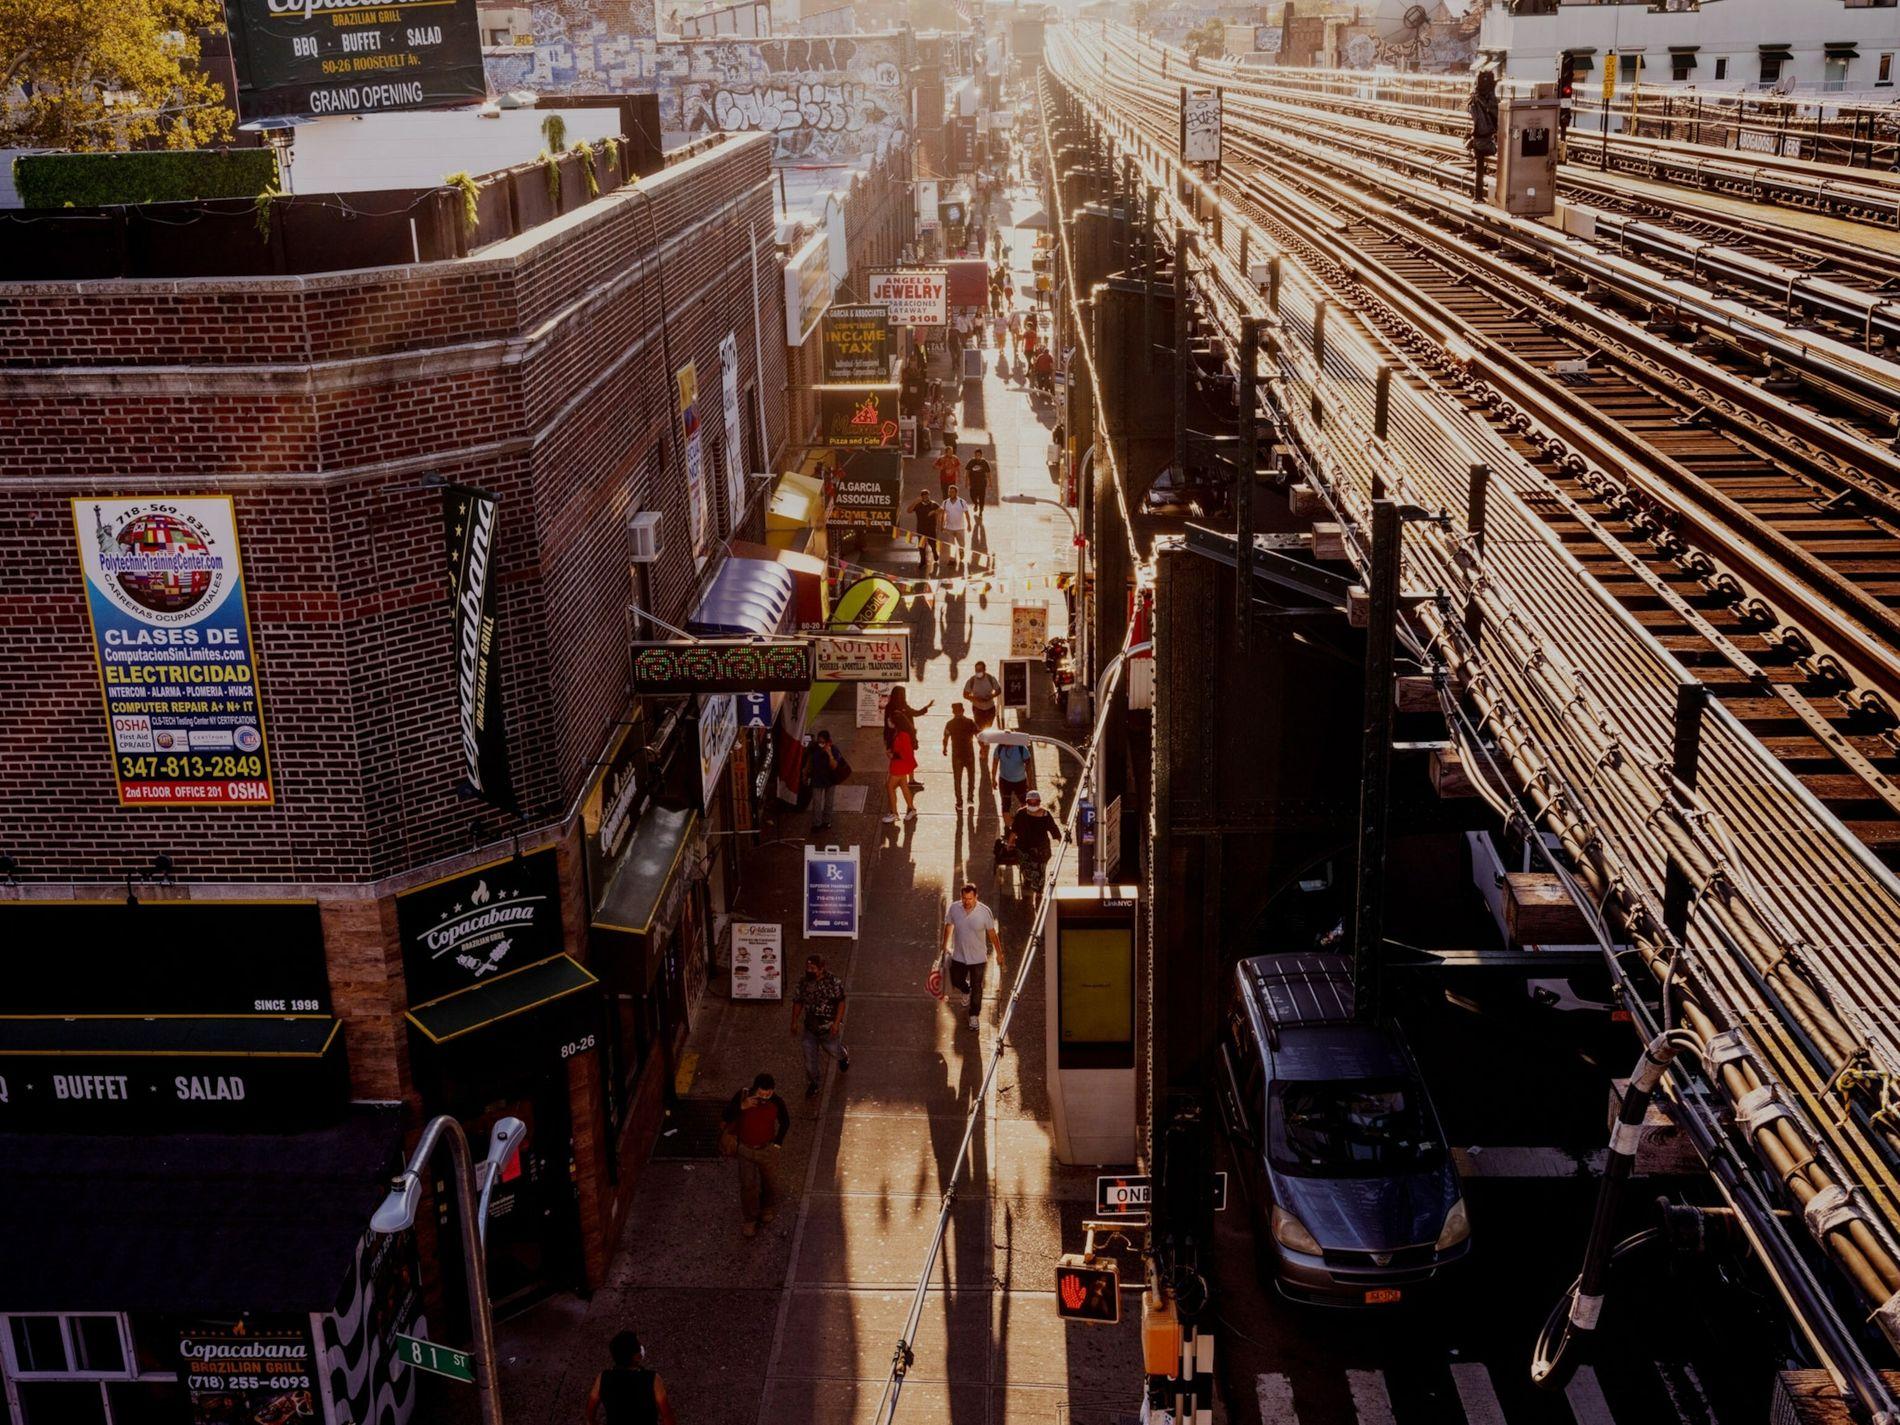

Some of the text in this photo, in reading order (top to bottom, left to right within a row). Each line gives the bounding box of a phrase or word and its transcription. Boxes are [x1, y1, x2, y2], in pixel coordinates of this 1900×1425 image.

[332, 9, 402, 27] BRAZILIAN GRILL
[293, 26, 442, 57] BBQ BUFFET SALAD
[322, 56, 351, 74] 80-26
[353, 54, 406, 71] ROOSEVELT
[310, 81, 423, 113] GRAND OPENING
[885, 276, 931, 285] ANGELO
[873, 285, 943, 299] JEWELRY
[825, 330, 886, 342] INCOME
[838, 342, 873, 354] TAX
[849, 437, 862, 445] and
[836, 494, 891, 505] ASSOCIATES
[870, 510, 891, 520] TAX
[99, 553, 223, 574] PolytechnicTrainingCenter.com
[104, 573, 223, 622] CARRERAS OCUPACIONALES
[105, 628, 239, 645] CLASES DE
[105, 647, 245, 664] ComputacionSinLimites.com
[105, 665, 251, 683] ELECTRICIDAD
[475, 615, 495, 731] BRAZILIAN GRILL
[108, 686, 254, 698] INTERCOM ALARMA PLOMERIA HVACR
[111, 701, 253, 713] COMPUTER REPAIR A+ N+ IT
[115, 719, 150, 732] OSHA
[177, 716, 194, 727] Testing
[217, 716, 256, 725] CERTIFICATIONS
[122, 756, 261, 778] 347-813-2849
[126, 782, 268, 800] 2nd FLOOR OFFICE 201 OSHA
[427, 907, 534, 950] Copacabana
[254, 1000, 319, 1011] SINCE 1998
[561, 1034, 595, 1058] 80-26
[53, 1075, 245, 1100] BUFFET SALAD
[180, 1339, 308, 1362] Copacabana
[191, 1362, 304, 1373] BRAZILIAN GRILL
[453, 1353, 466, 1367] ST
[188, 1376, 310, 1390] (718) 255-6093
